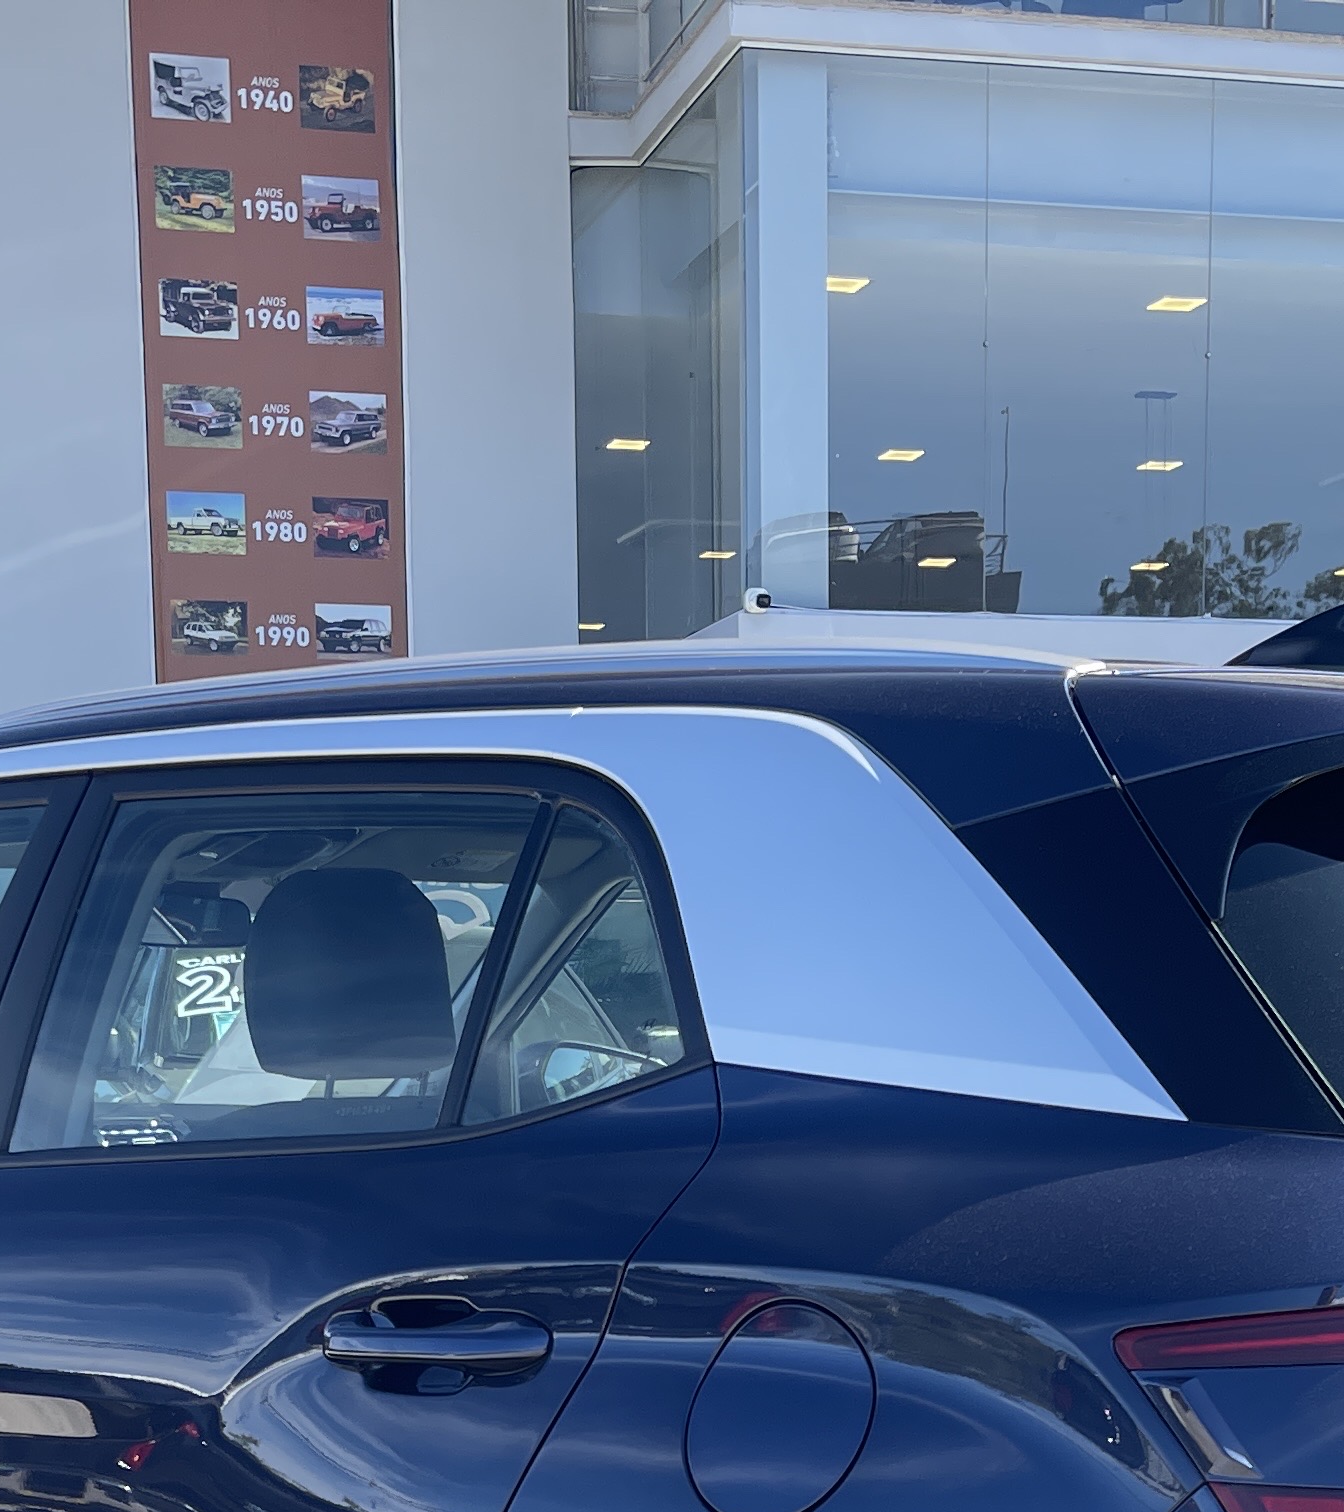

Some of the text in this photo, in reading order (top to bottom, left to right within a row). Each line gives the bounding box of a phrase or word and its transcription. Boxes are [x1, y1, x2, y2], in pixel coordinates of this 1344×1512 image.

[251, 76, 280, 88] ANOS
[237, 88, 294, 113] 1940
[255, 187, 283, 199] ANOS
[242, 199, 298, 223] 1950
[258, 296, 287, 307] ANOS
[244, 307, 301, 331] 1960
[262, 403, 291, 414] ANOS
[248, 415, 305, 438] 1970
[265, 509, 293, 520] ANOS
[252, 520, 307, 543] 1980
[268, 614, 297, 625] ANOS
[255, 626, 310, 647] 1990
